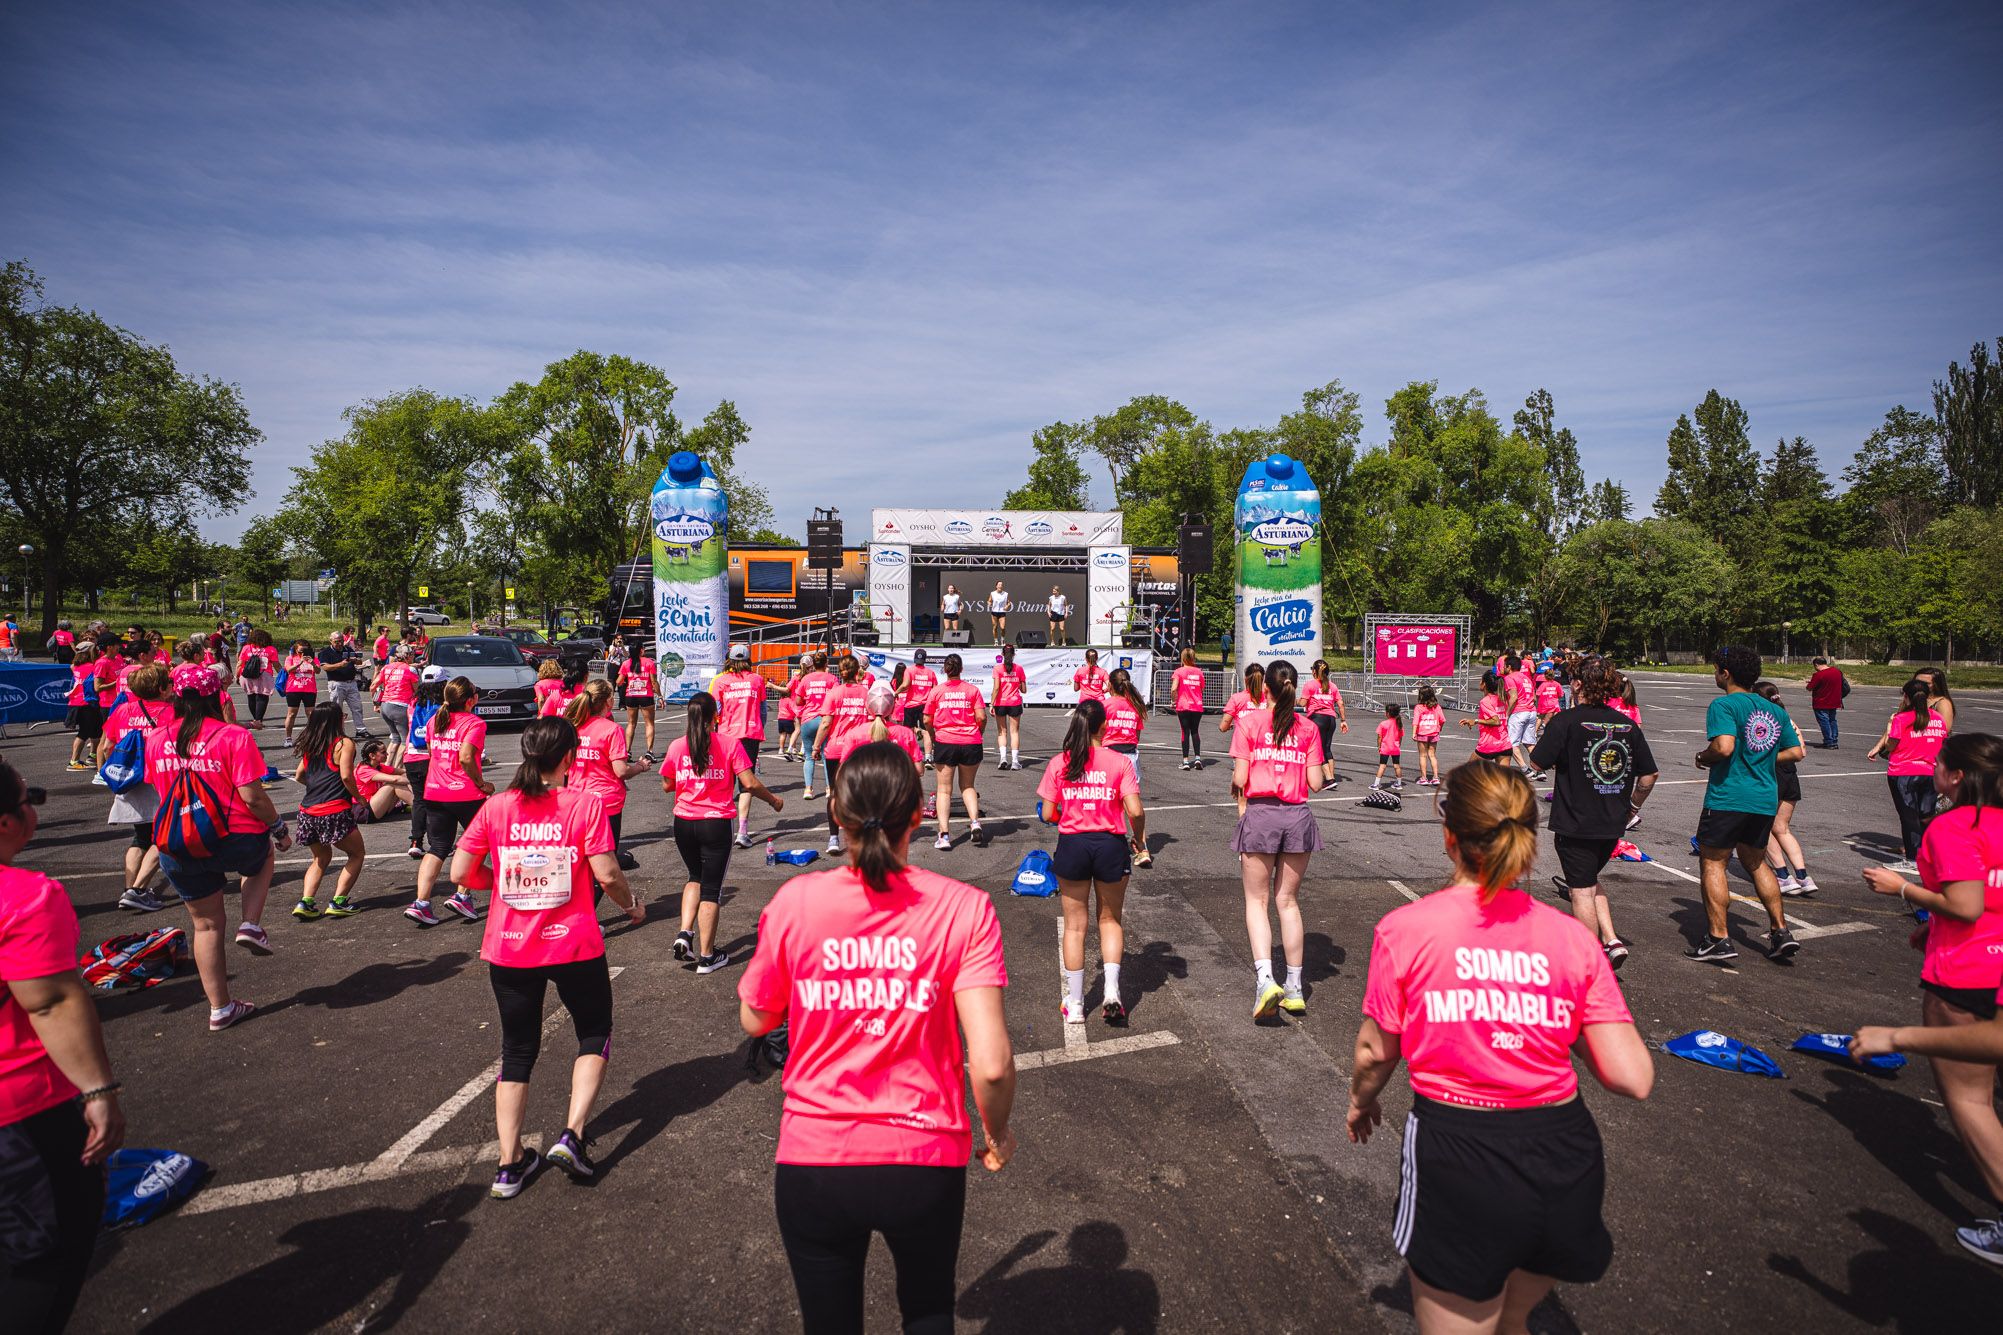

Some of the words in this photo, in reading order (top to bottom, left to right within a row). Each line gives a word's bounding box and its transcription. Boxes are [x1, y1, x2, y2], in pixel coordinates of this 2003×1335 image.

[659, 525, 710, 537] ASTURIANA
[1255, 528, 1310, 540] ASTURIANA
[876, 555, 904, 563] ASTURIANA
[1096, 557, 1124, 565] ASTURIANA
[874, 583, 905, 591] OYSHO
[661, 592, 689, 610] Leche
[1254, 596, 1270, 607] Leche
[1271, 594, 1283, 602] rica
[658, 605, 716, 629] semi
[1255, 605, 1307, 631] Calcio
[660, 627, 717, 643] desnatada
[1278, 628, 1306, 641] natural
[1257, 647, 1306, 657] semidesnatada
[730, 680, 751, 689] SOMOS
[842, 697, 865, 706] SOMOS
[944, 691, 966, 700] SOMOS
[510, 822, 563, 841] SOMOS
[522, 876, 549, 888] 016
[822, 936, 918, 972] SOMOS
[1455, 946, 1551, 987] SOMOS
[1491, 1031, 1525, 1050] 2026
